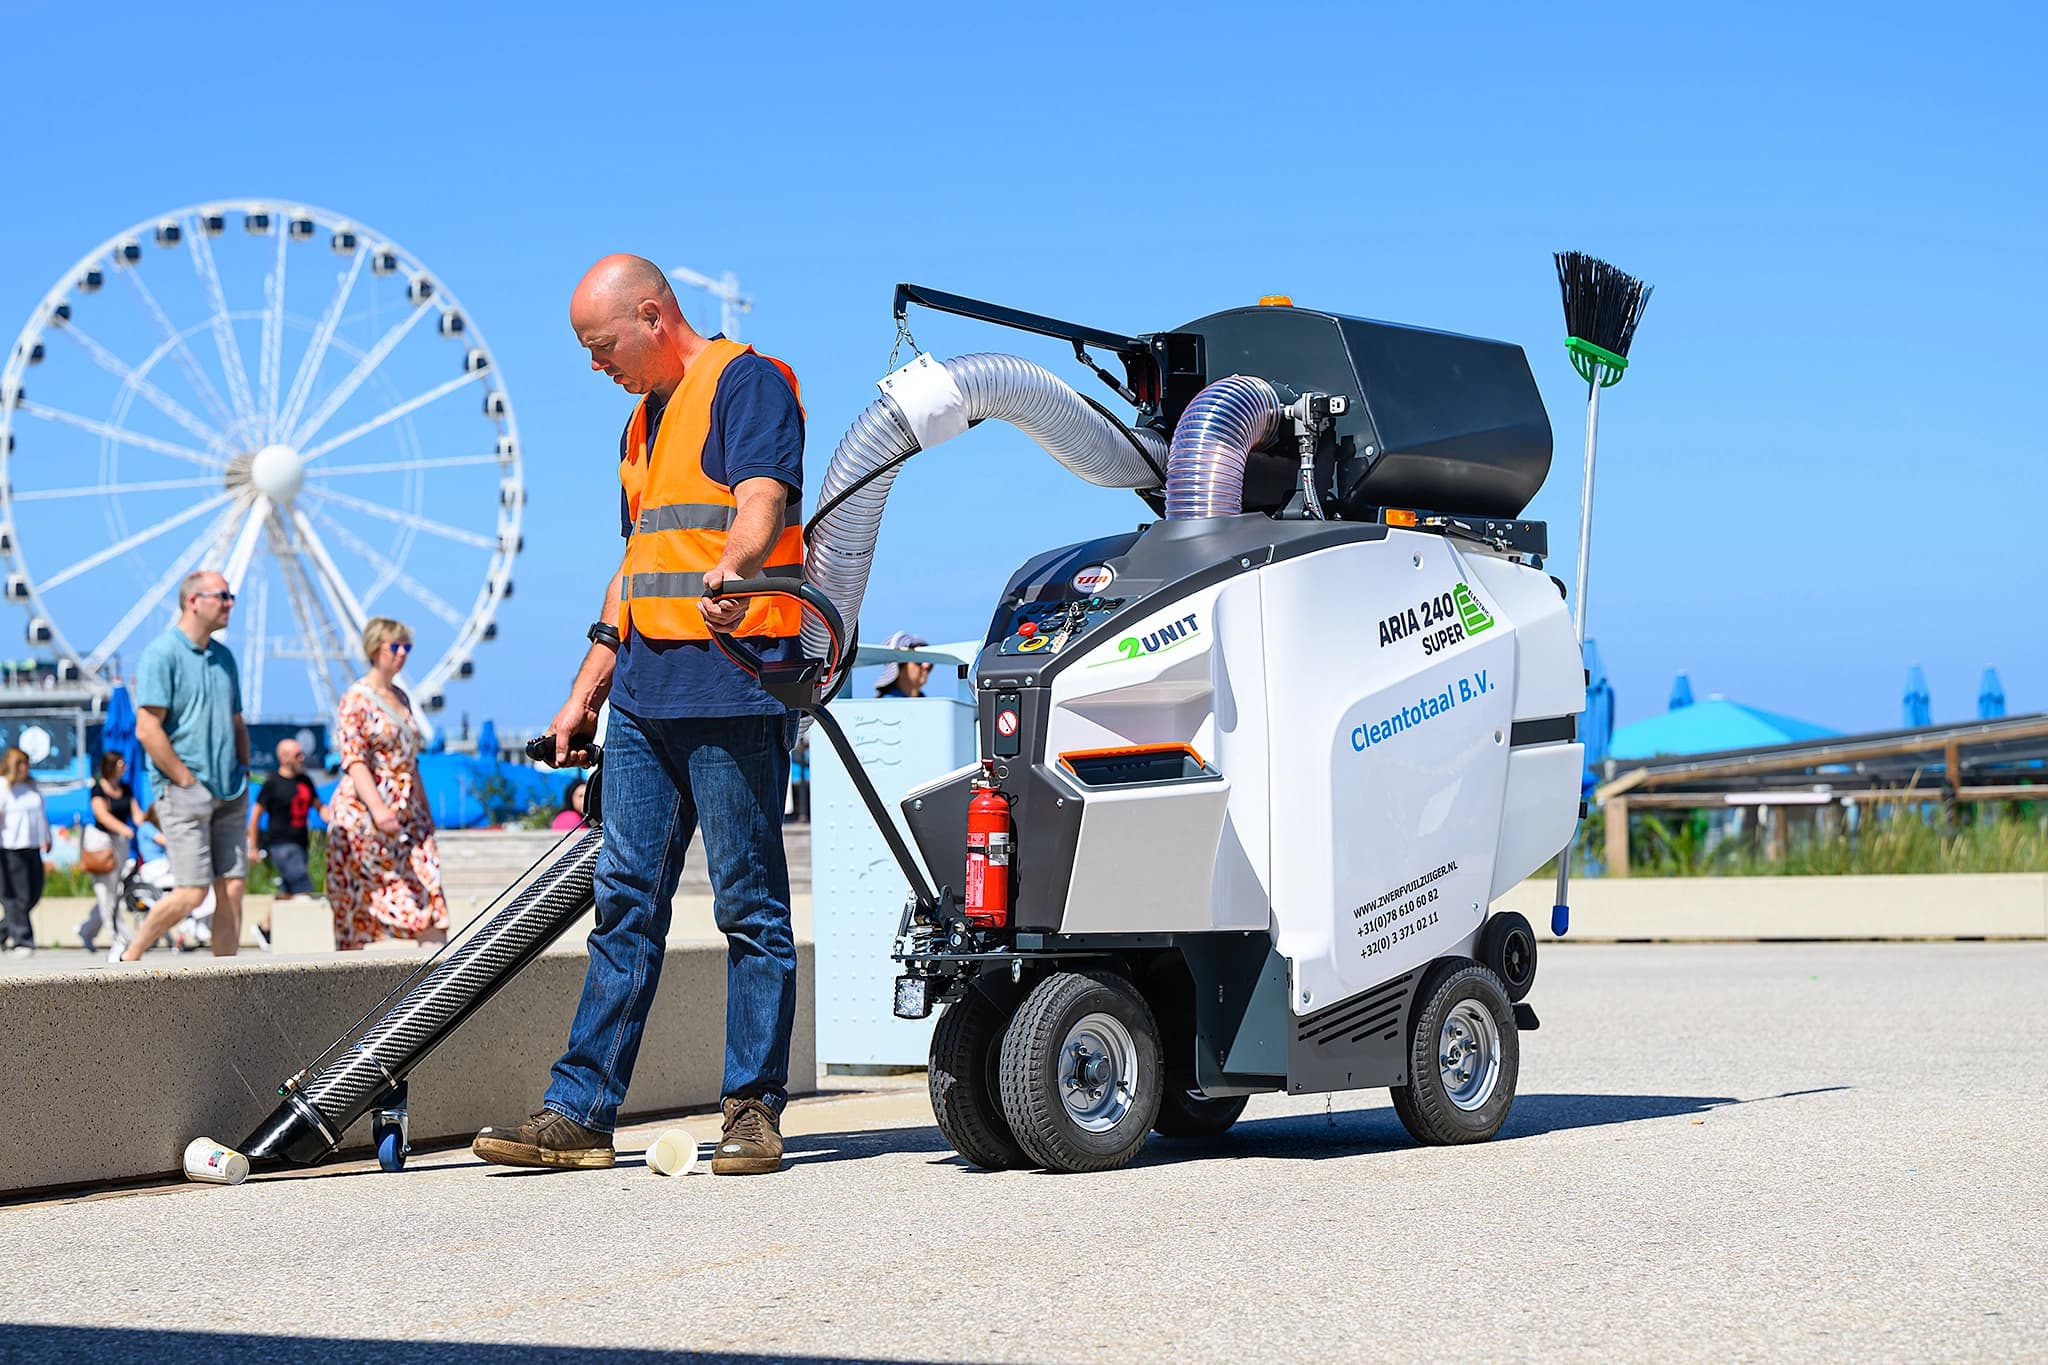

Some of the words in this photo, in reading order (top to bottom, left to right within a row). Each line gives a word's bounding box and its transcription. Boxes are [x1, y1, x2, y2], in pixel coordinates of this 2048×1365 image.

[1378, 608, 1421, 648] ARIA
[1420, 592, 1455, 628] 240
[1467, 589, 1490, 618] ELECTRIC
[1422, 622, 1465, 656] SUPER
[1351, 684, 1456, 753] Cleantotaal
[1458, 669, 1495, 703] B.V.
[1353, 860, 1459, 920] WWW.ZWERFVUILZUIGER.NL
[1357, 909, 1398, 938] +31(0)78
[1398, 900, 1415, 917] 610
[1416, 894, 1427, 908] 60
[1427, 888, 1439, 904] 82
[1360, 935, 1391, 960] +32(0)
[1391, 931, 1398, 944] 3
[1399, 925, 1416, 941] 371
[1416, 917, 1428, 931] 02
[1428, 911, 1440, 926] 11
